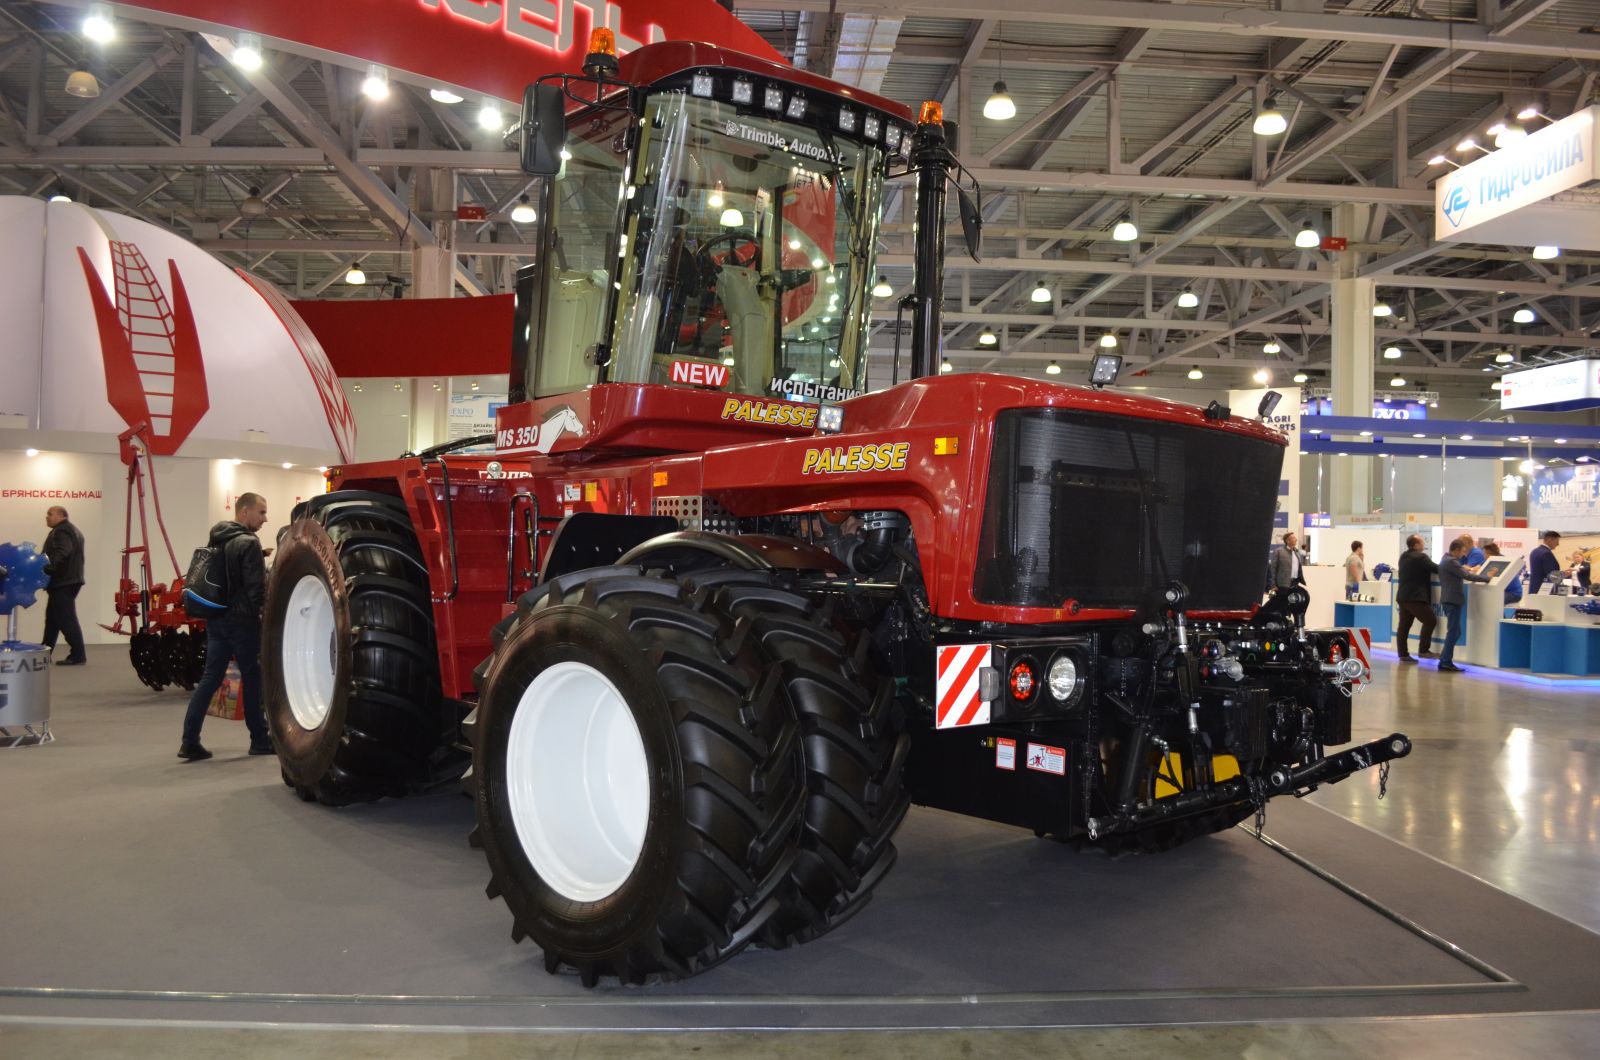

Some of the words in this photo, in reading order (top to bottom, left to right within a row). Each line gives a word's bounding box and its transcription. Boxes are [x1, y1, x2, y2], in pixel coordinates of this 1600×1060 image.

[739, 124, 786, 148] Trimble
[789, 138, 843, 164] Autopit
[1480, 132, 1584, 205] ГИДРОСИЛА
[673, 361, 726, 386] NEW
[721, 398, 818, 428] PALESSE
[497, 429, 514, 448] MS
[516, 425, 539, 446] 350
[802, 442, 910, 474] PALESSE
[2, 489, 103, 499] БРЯНСКСЕЛЬМАШ
[1539, 483, 1596, 505] ЗАПАСНЫЕ
